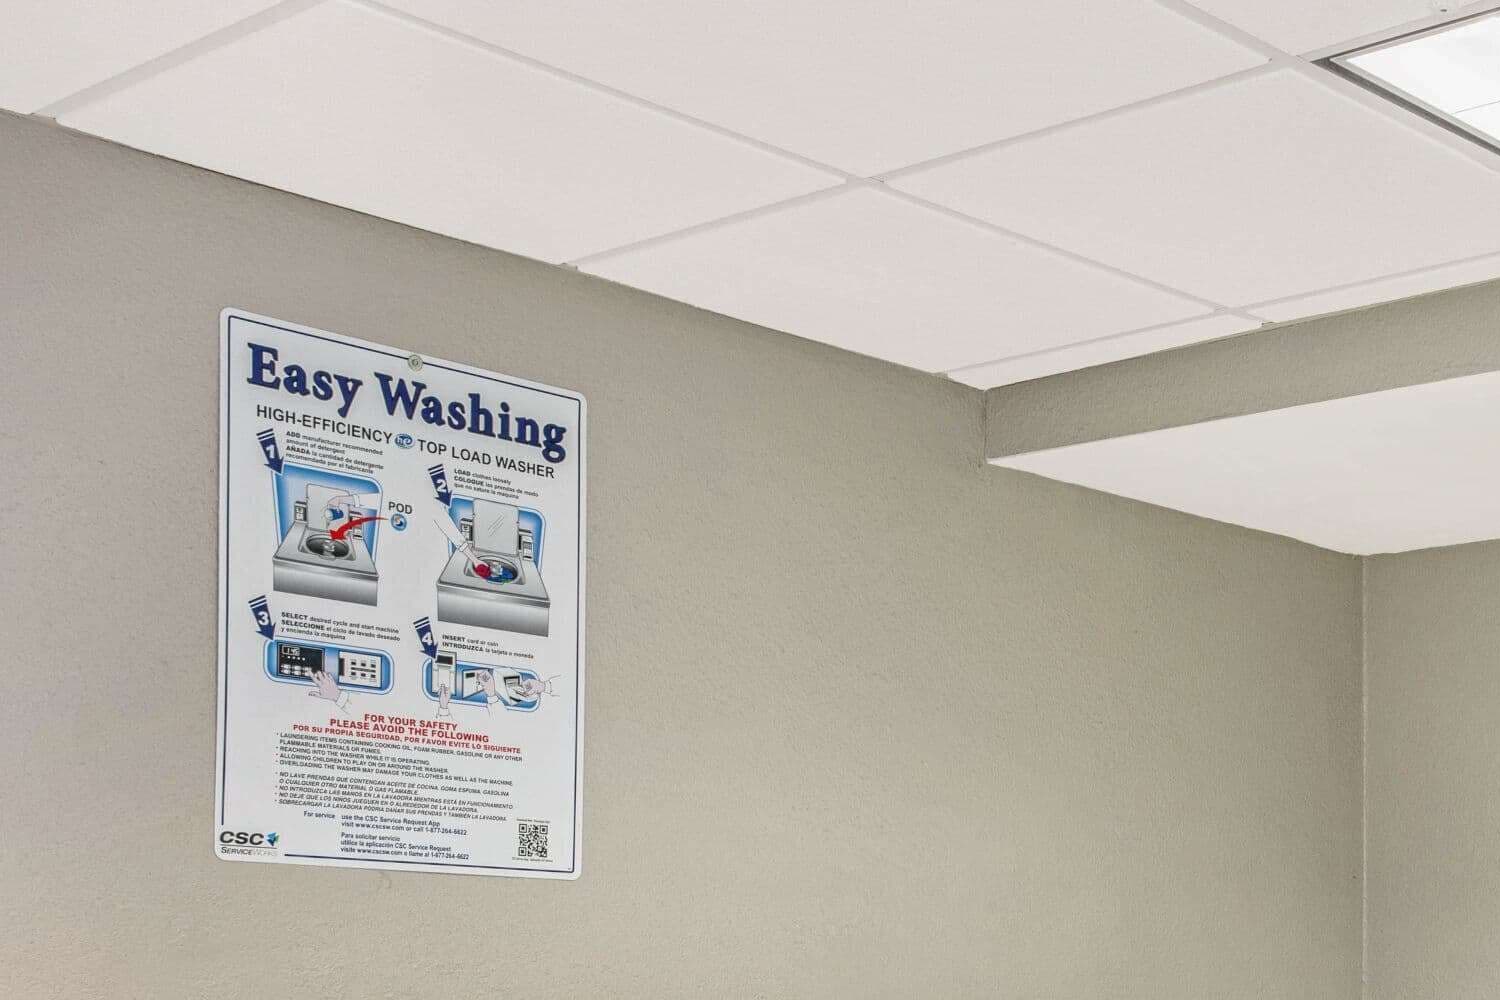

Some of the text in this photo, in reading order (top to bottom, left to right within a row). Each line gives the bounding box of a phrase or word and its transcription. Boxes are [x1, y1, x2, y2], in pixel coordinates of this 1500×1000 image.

[247, 343, 566, 463] Easy Washing
[257, 405, 392, 444] HIGH-EFFICIENCY
[418, 439, 446, 454] TOP
[452, 447, 491, 465] LOAD
[496, 456, 554, 478] WASHER
[266, 445, 275, 458] 1
[437, 480, 446, 492] 2
[454, 476, 484, 486] COLOQUE
[388, 502, 412, 515] POD
[258, 612, 268, 625] 3
[282, 612, 308, 620] SELECT
[282, 620, 325, 631] SELECCIONE
[422, 632, 433, 645] 4
[442, 642, 483, 652] INTRODUZCA
[365, 714, 457, 730] FOR YOUR SAFETY
[330, 719, 489, 742] PLEASE AVOID THE FOLLOWING
[325, 728, 353, 736] PROPIA
[421, 738, 446, 746] FAVOR
[484, 744, 521, 754] SIGUIENTE
[355, 823, 404, 831] www.cscsw.com
[220, 831, 264, 845] CSC
